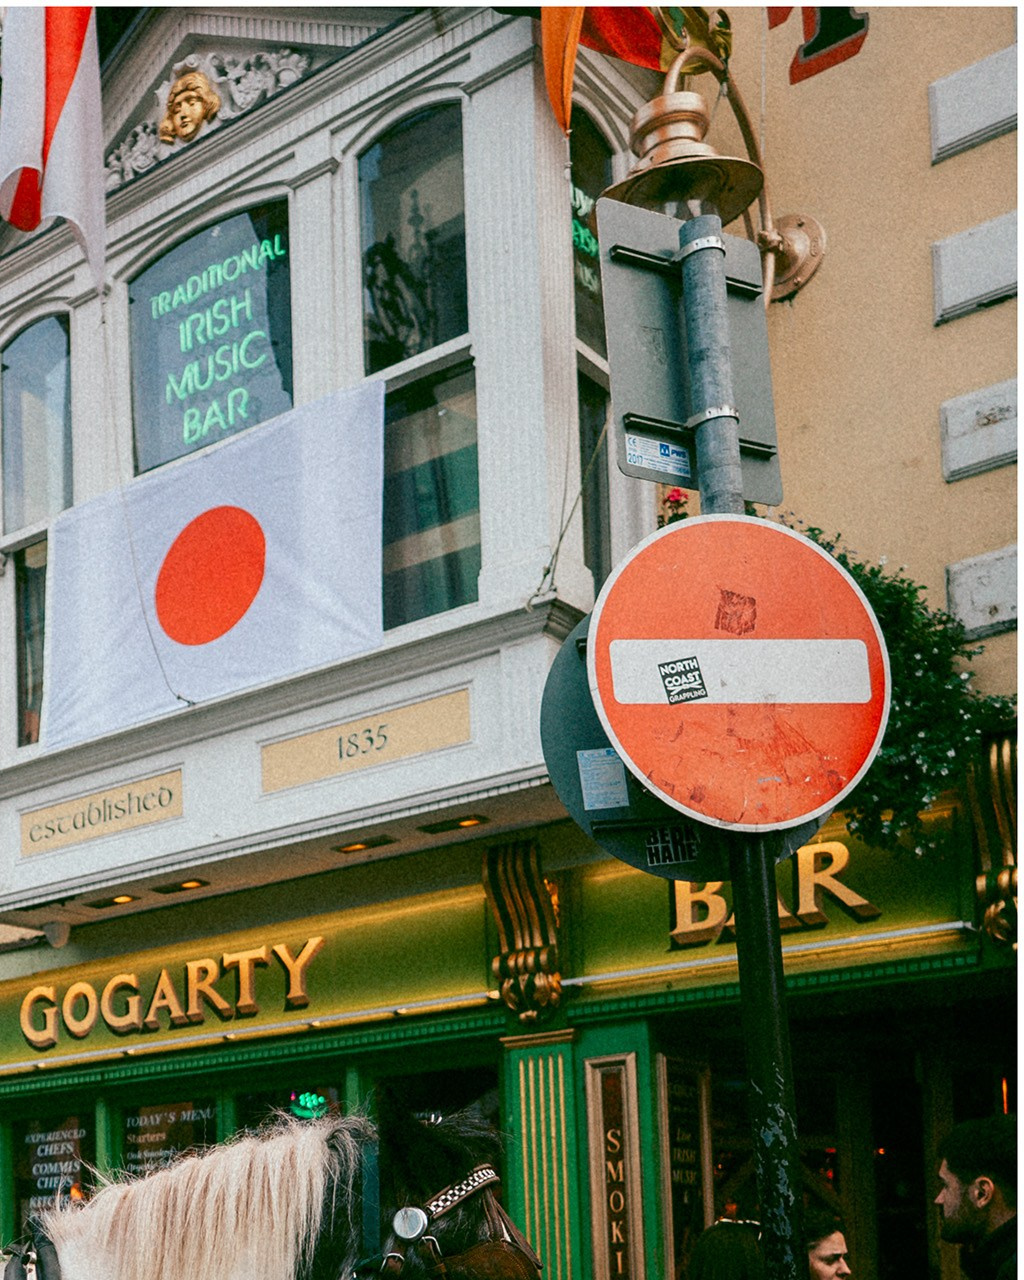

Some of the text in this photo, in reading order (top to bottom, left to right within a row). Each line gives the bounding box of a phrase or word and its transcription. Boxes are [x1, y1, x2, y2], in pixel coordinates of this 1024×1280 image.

[149, 234, 285, 319] TRADITIONAL
[179, 287, 253, 352] IRISH
[166, 330, 267, 404] MUSIC
[183, 387, 249, 445] BAR
[628, 453, 643, 465] 2017
[660, 659, 698, 676] NORTH
[665, 671, 701, 687] COAST
[669, 688, 706, 703] GRAPPLING
[338, 724, 389, 761] 1835
[28, 786, 173, 844] established
[670, 841, 882, 942] BR
[19, 936, 325, 1051] GOGARTY
[126, 1106, 216, 1129] TODAY'S MENU
[25, 1128, 86, 1144] EXPERIENCED
[126, 1132, 167, 1145] Starters
[37, 1141, 75, 1157] CHEFS
[32, 1160, 81, 1176] COMMIS
